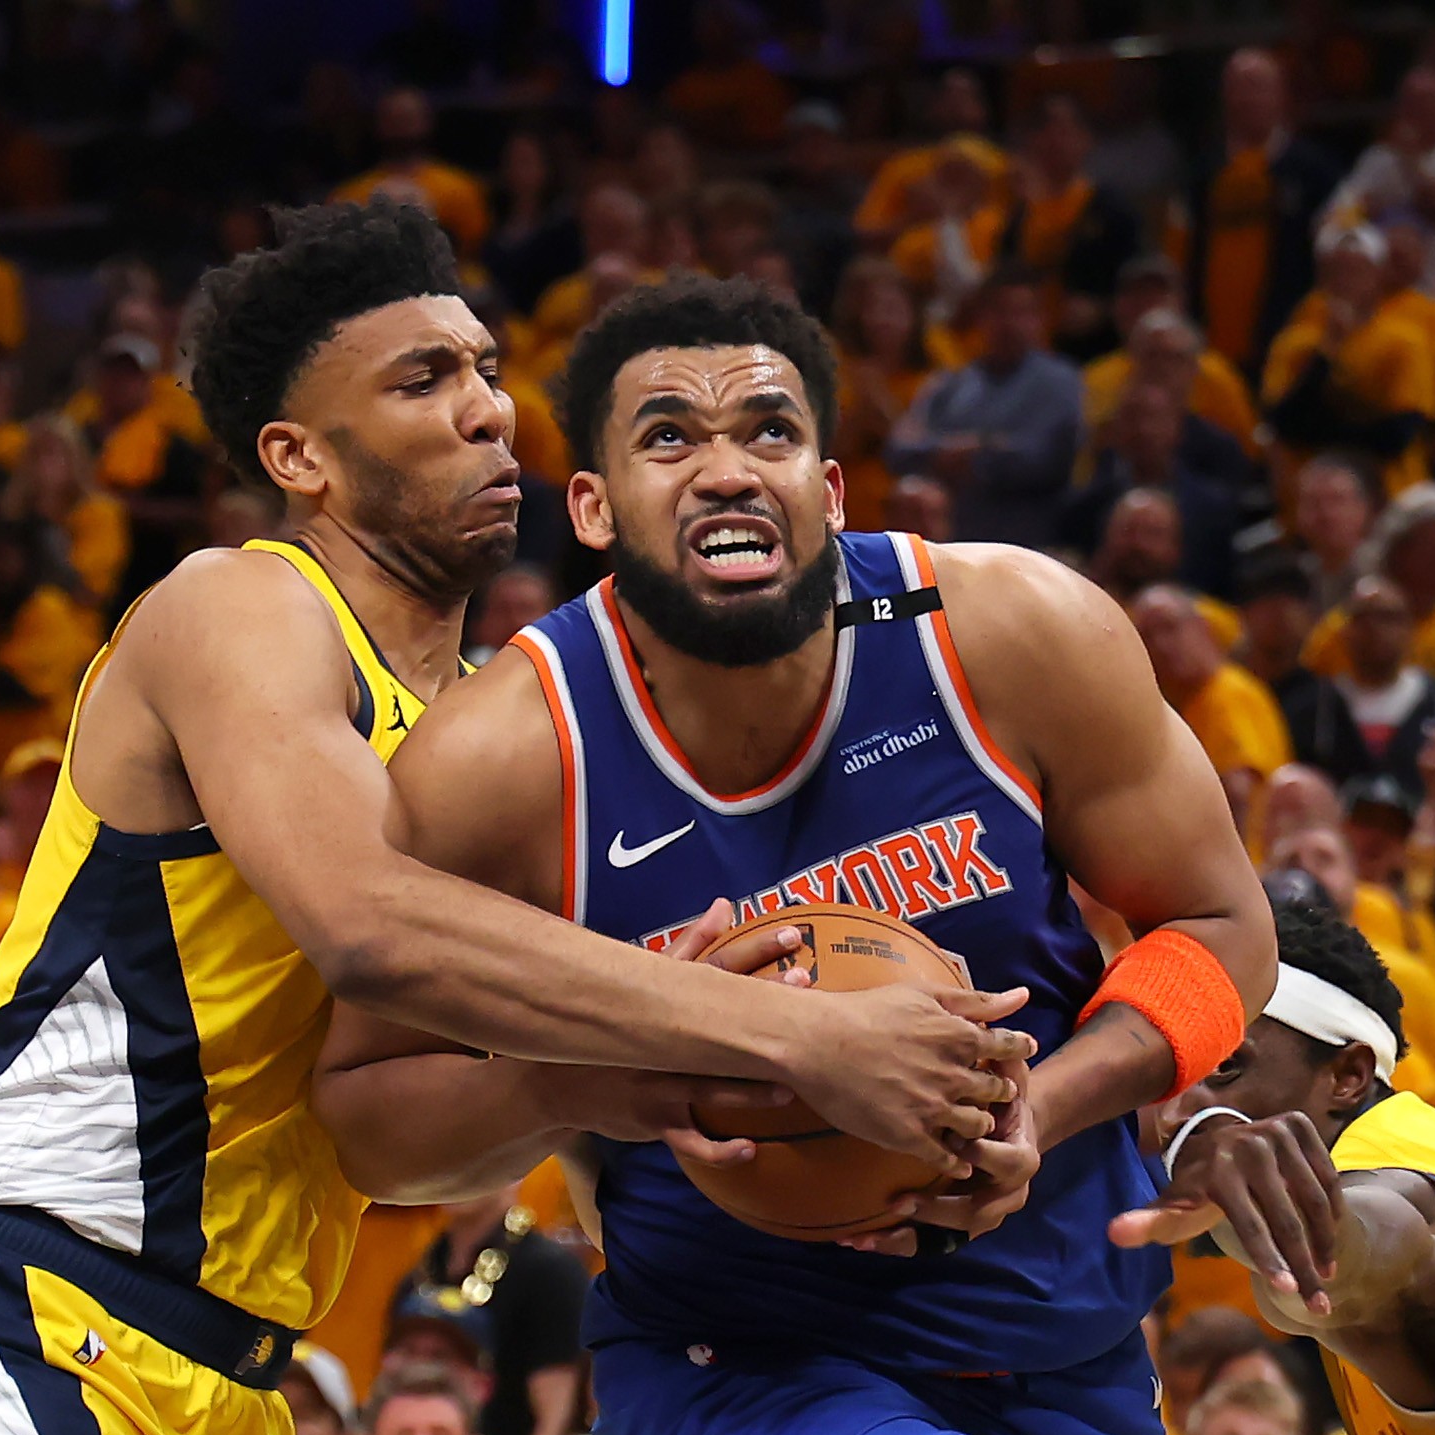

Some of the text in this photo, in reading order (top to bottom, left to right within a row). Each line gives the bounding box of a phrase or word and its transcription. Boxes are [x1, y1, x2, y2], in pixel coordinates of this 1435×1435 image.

[872, 598, 893, 620] 12
[843, 718, 940, 774] abu dhabi
